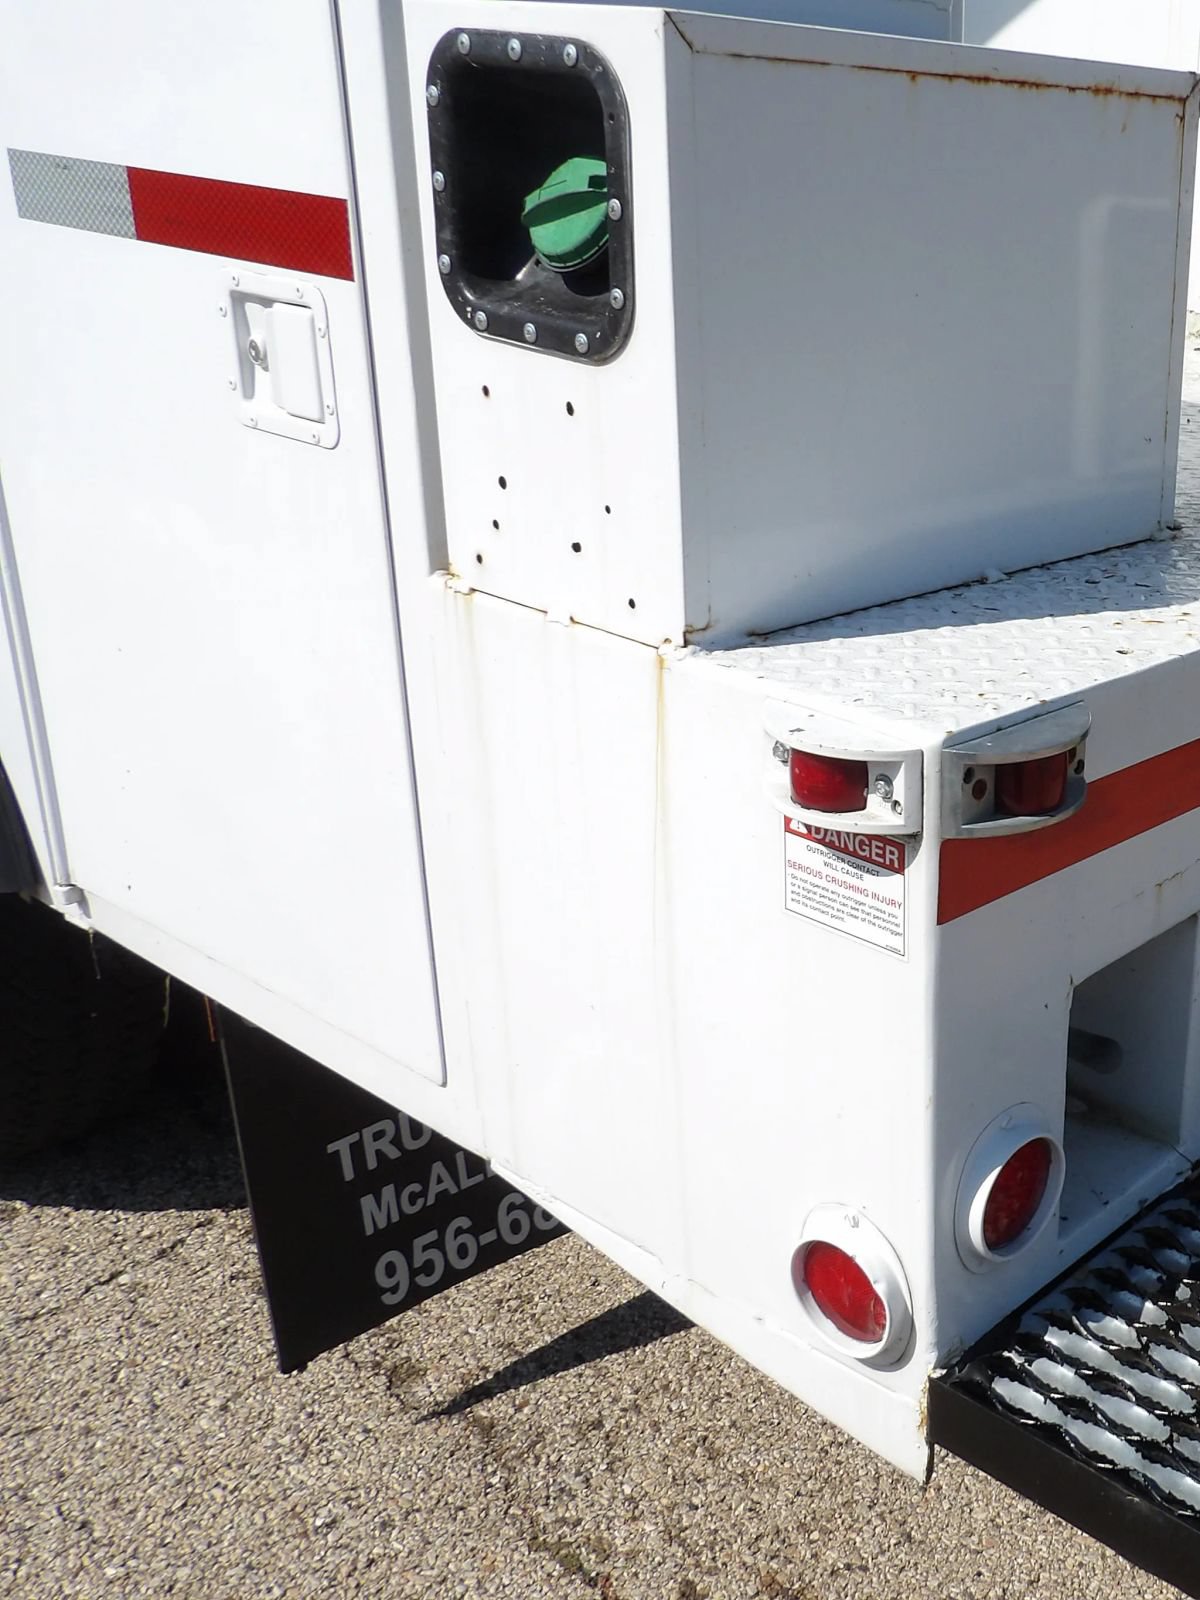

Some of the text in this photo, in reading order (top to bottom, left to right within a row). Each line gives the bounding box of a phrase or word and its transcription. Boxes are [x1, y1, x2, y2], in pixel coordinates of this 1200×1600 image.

[806, 844, 880, 877] OUTRIGGER CONTACT
[811, 826, 899, 869] DANGER
[788, 860, 903, 910] SERIOUS CRUSHING INJURY
[823, 860, 865, 881] WILL CAUSE
[802, 894, 835, 910] obstructions
[878, 924, 903, 936] outrigger
[810, 905, 829, 915] contact
[819, 893, 837, 904] person
[873, 914, 900, 928] personnel
[831, 890, 840, 898] any
[842, 894, 867, 907] outrigger
[868, 904, 886, 914] unless
[360, 1150, 496, 1236] McAL
